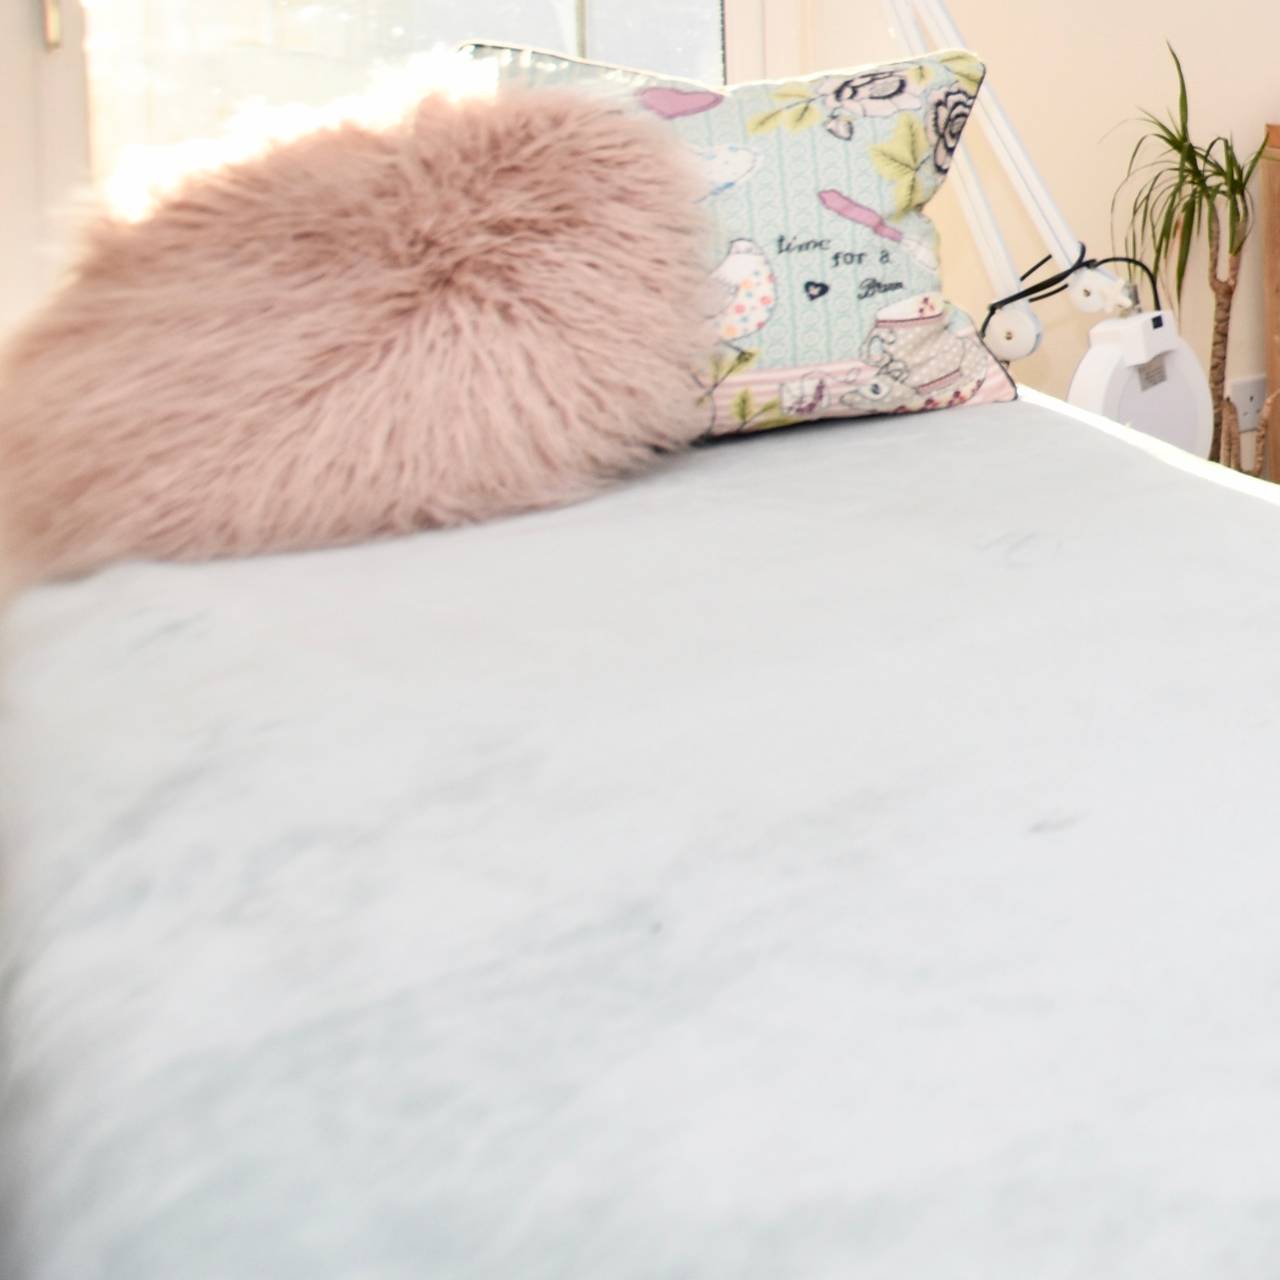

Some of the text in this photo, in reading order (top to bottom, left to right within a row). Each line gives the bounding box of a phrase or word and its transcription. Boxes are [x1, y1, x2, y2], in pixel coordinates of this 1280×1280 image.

[777, 235, 831, 254] time
[831, 249, 891, 268] for a
